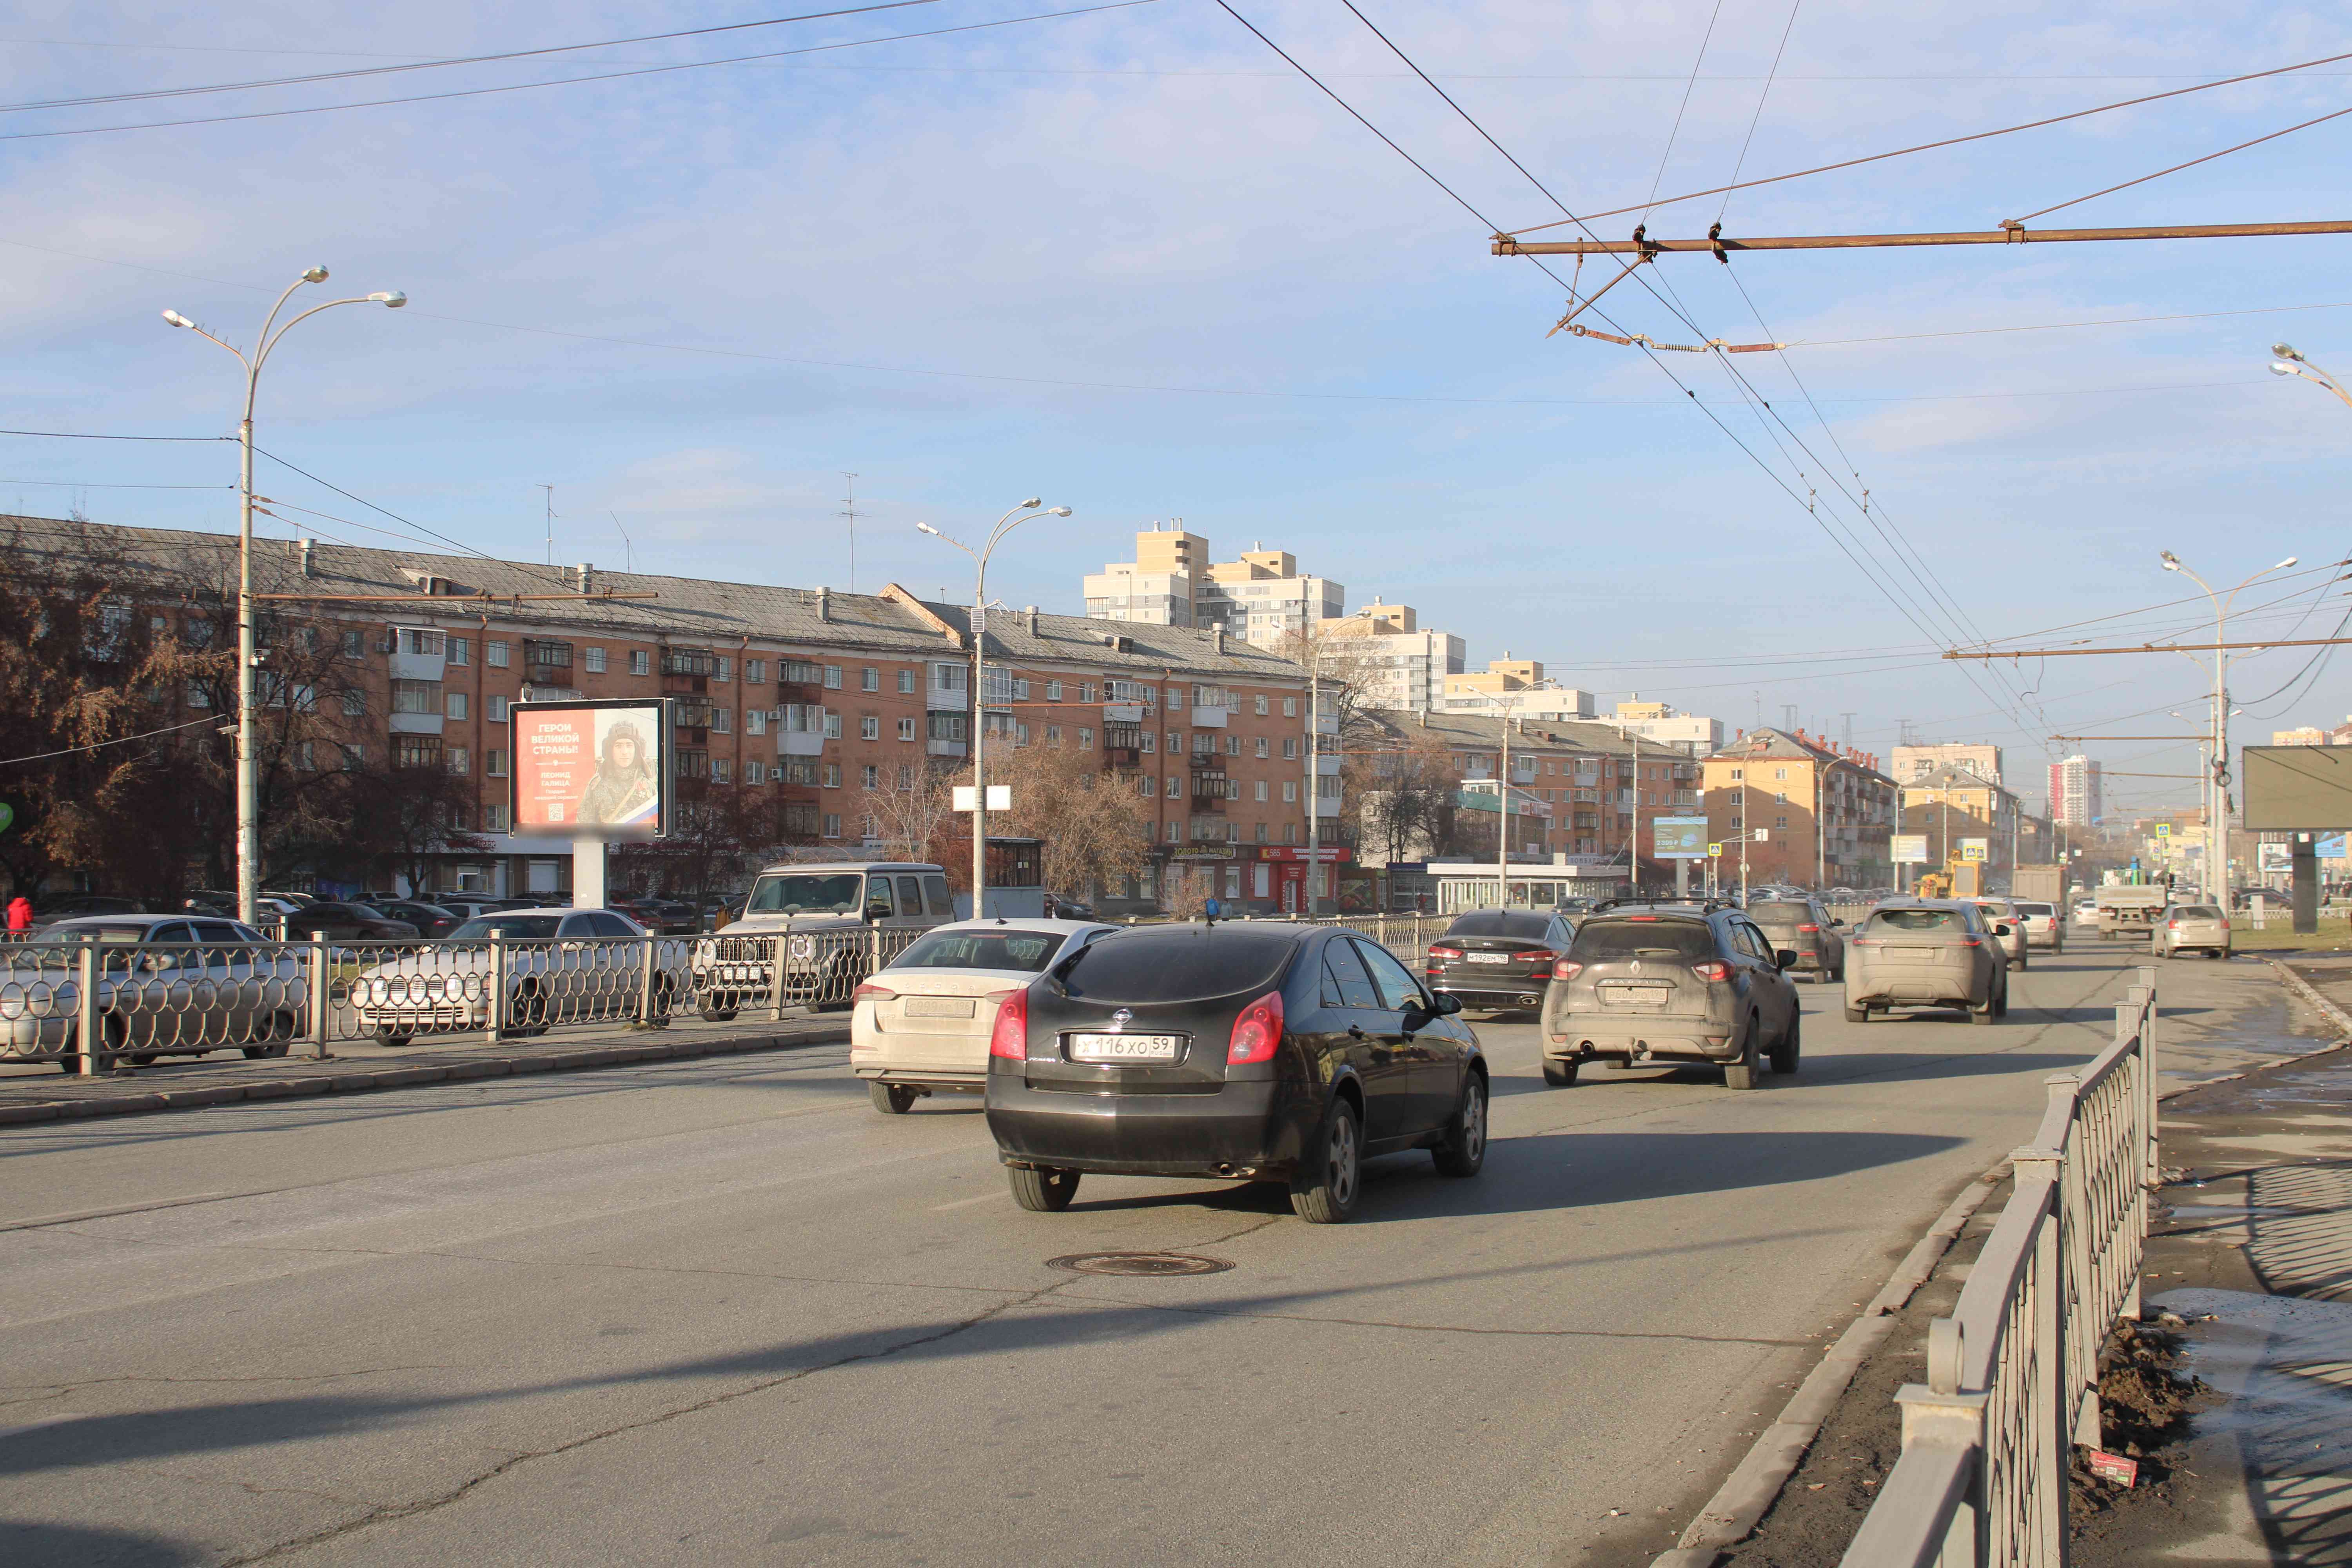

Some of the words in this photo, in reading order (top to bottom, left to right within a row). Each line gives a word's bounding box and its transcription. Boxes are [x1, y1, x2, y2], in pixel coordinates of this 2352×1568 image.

[539, 724, 571, 732] ГЕРОИ
[531, 733, 579, 743] ВЕЛИКОЙ
[533, 745, 578, 755] СТРАНЫ!
[1174, 848, 1198, 856] ЗОЛОТО
[1209, 848, 1232, 857] МАГАЗИН
[954, 1002, 970, 1010] 196
[1152, 1037, 1169, 1050] 59
